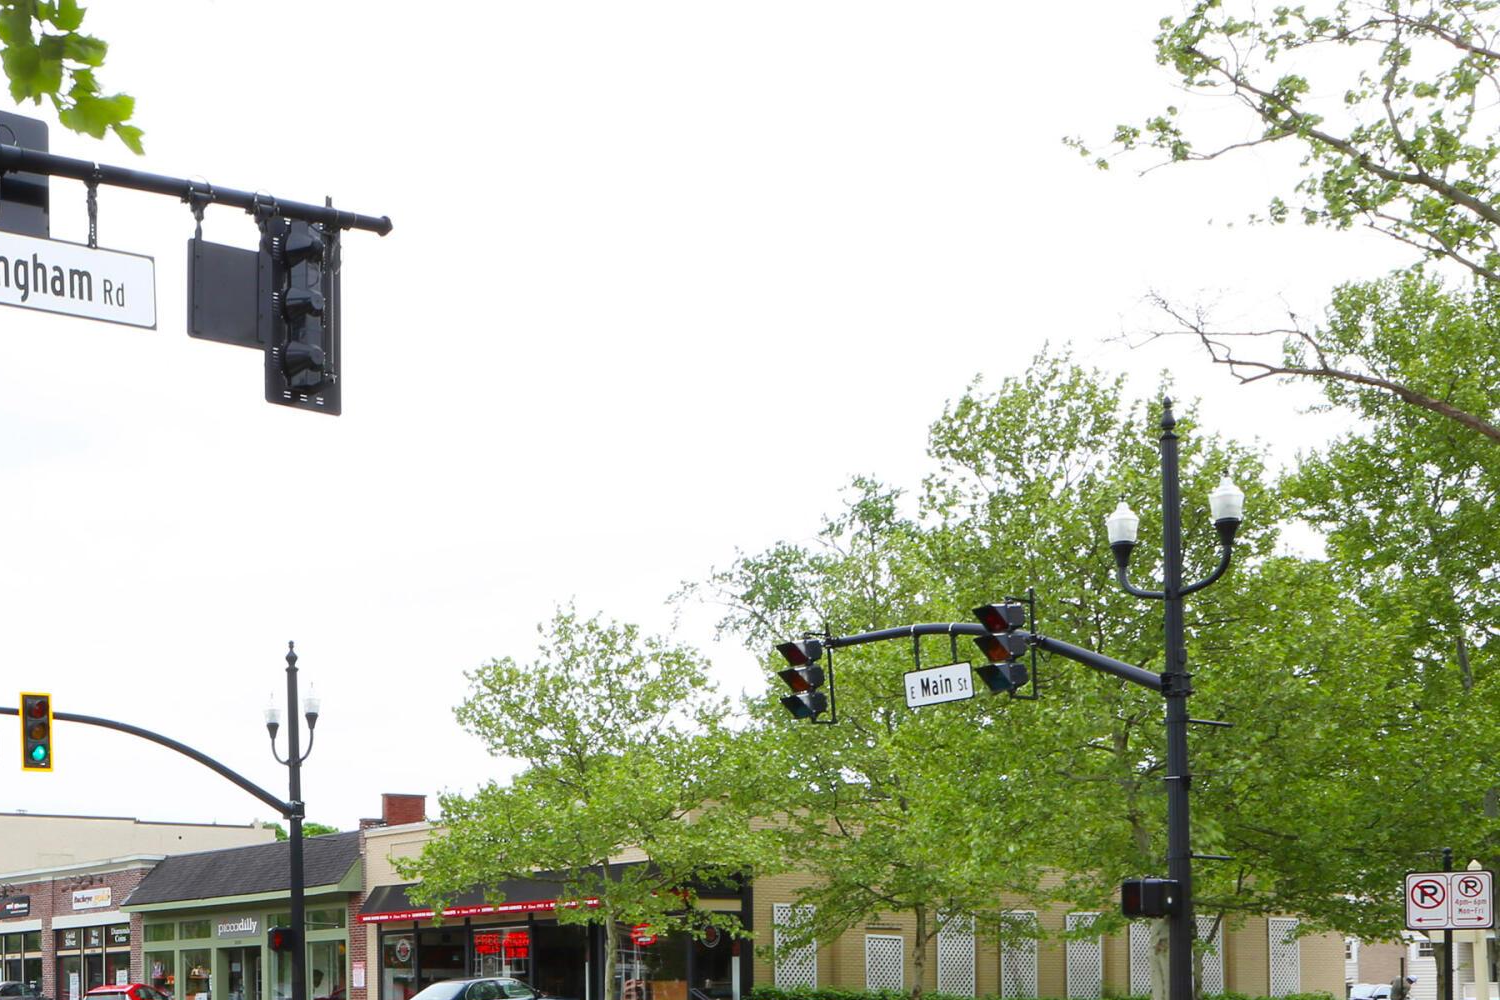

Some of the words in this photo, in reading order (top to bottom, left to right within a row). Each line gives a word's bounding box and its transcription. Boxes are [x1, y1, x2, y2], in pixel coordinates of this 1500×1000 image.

[103, 279, 125, 307] Rd
[910, 686, 916, 699] E
[920, 674, 952, 697] Main
[957, 677, 968, 691] St
[218, 917, 257, 936] piccadilly
